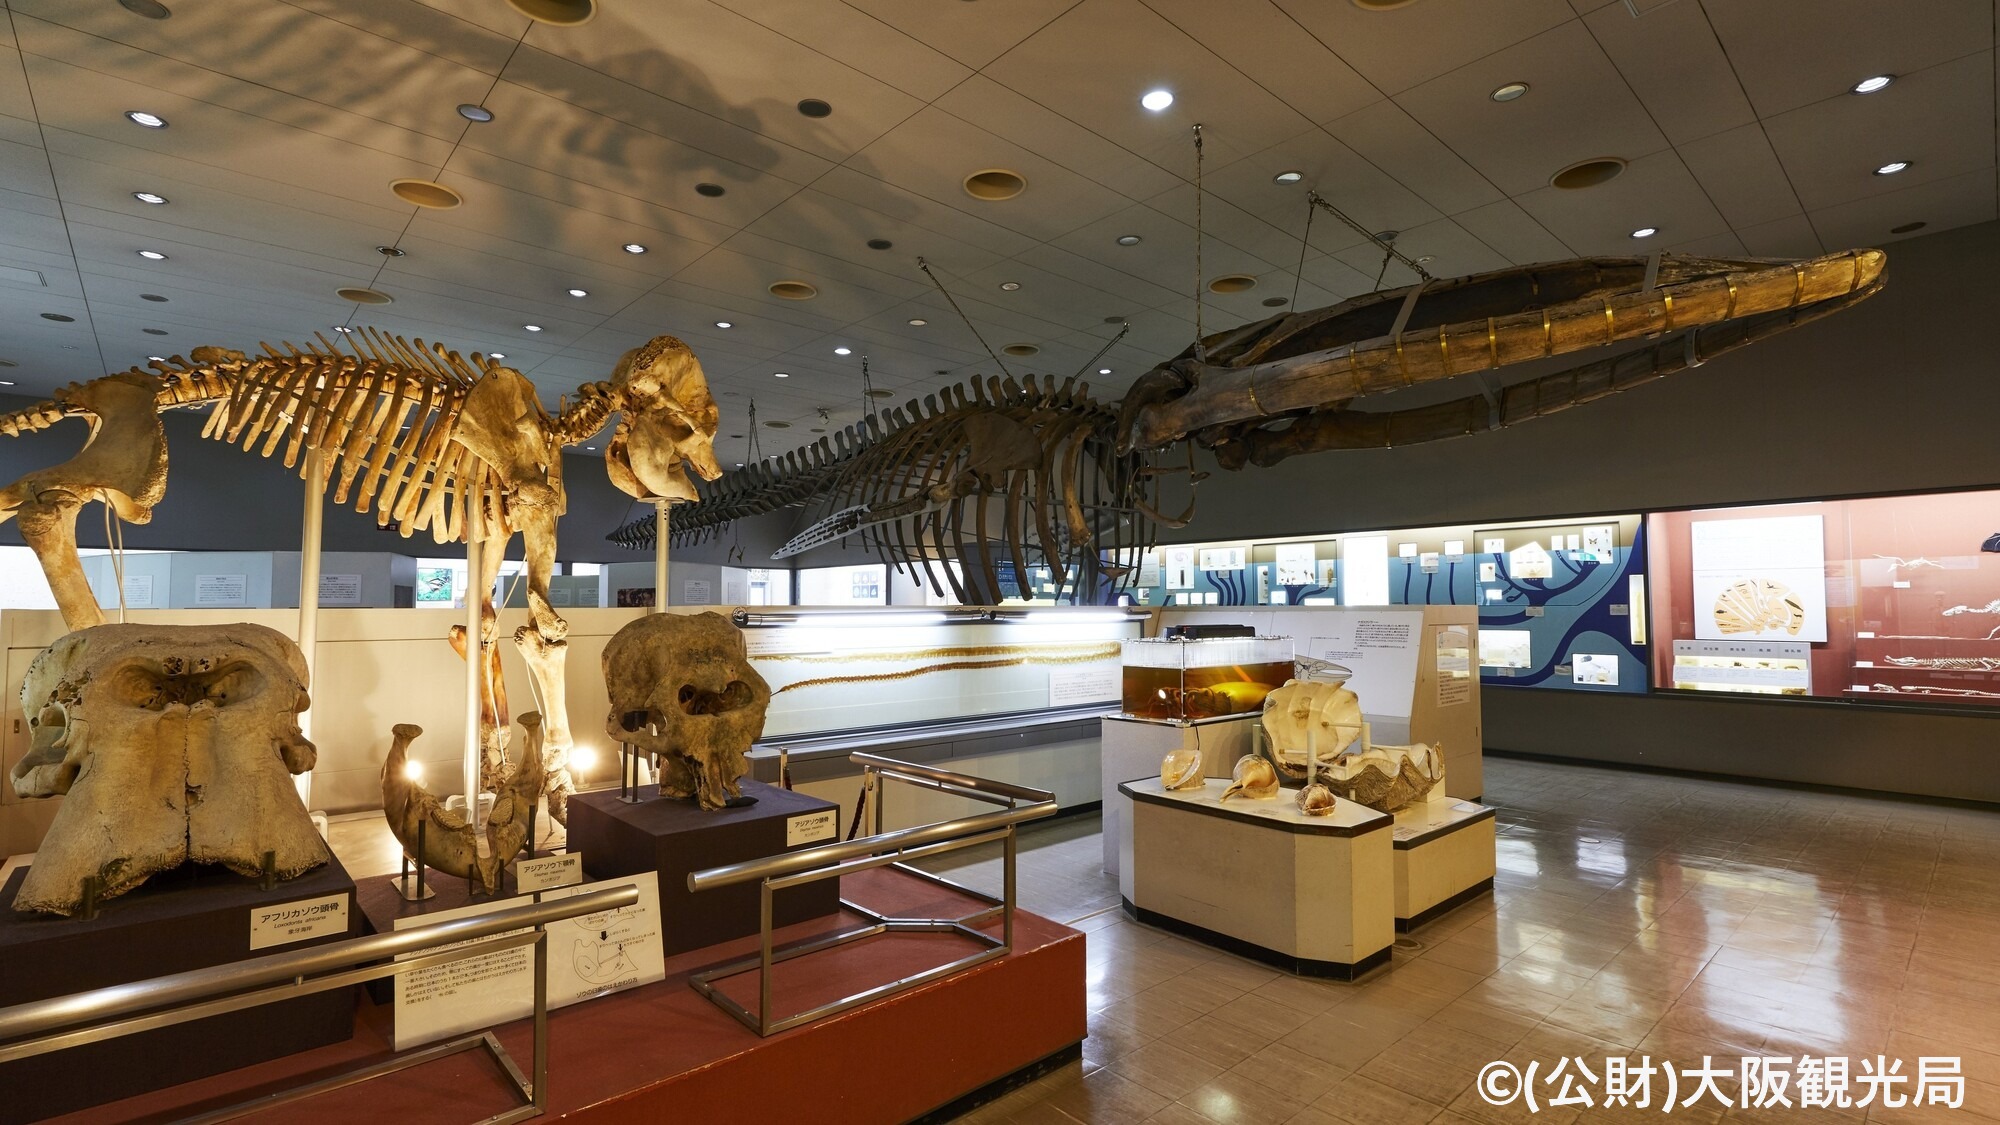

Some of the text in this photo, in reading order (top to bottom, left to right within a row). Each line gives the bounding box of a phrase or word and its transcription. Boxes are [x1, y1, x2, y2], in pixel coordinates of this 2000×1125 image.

[261, 902, 340, 924] アフリカゾウ頭骨
